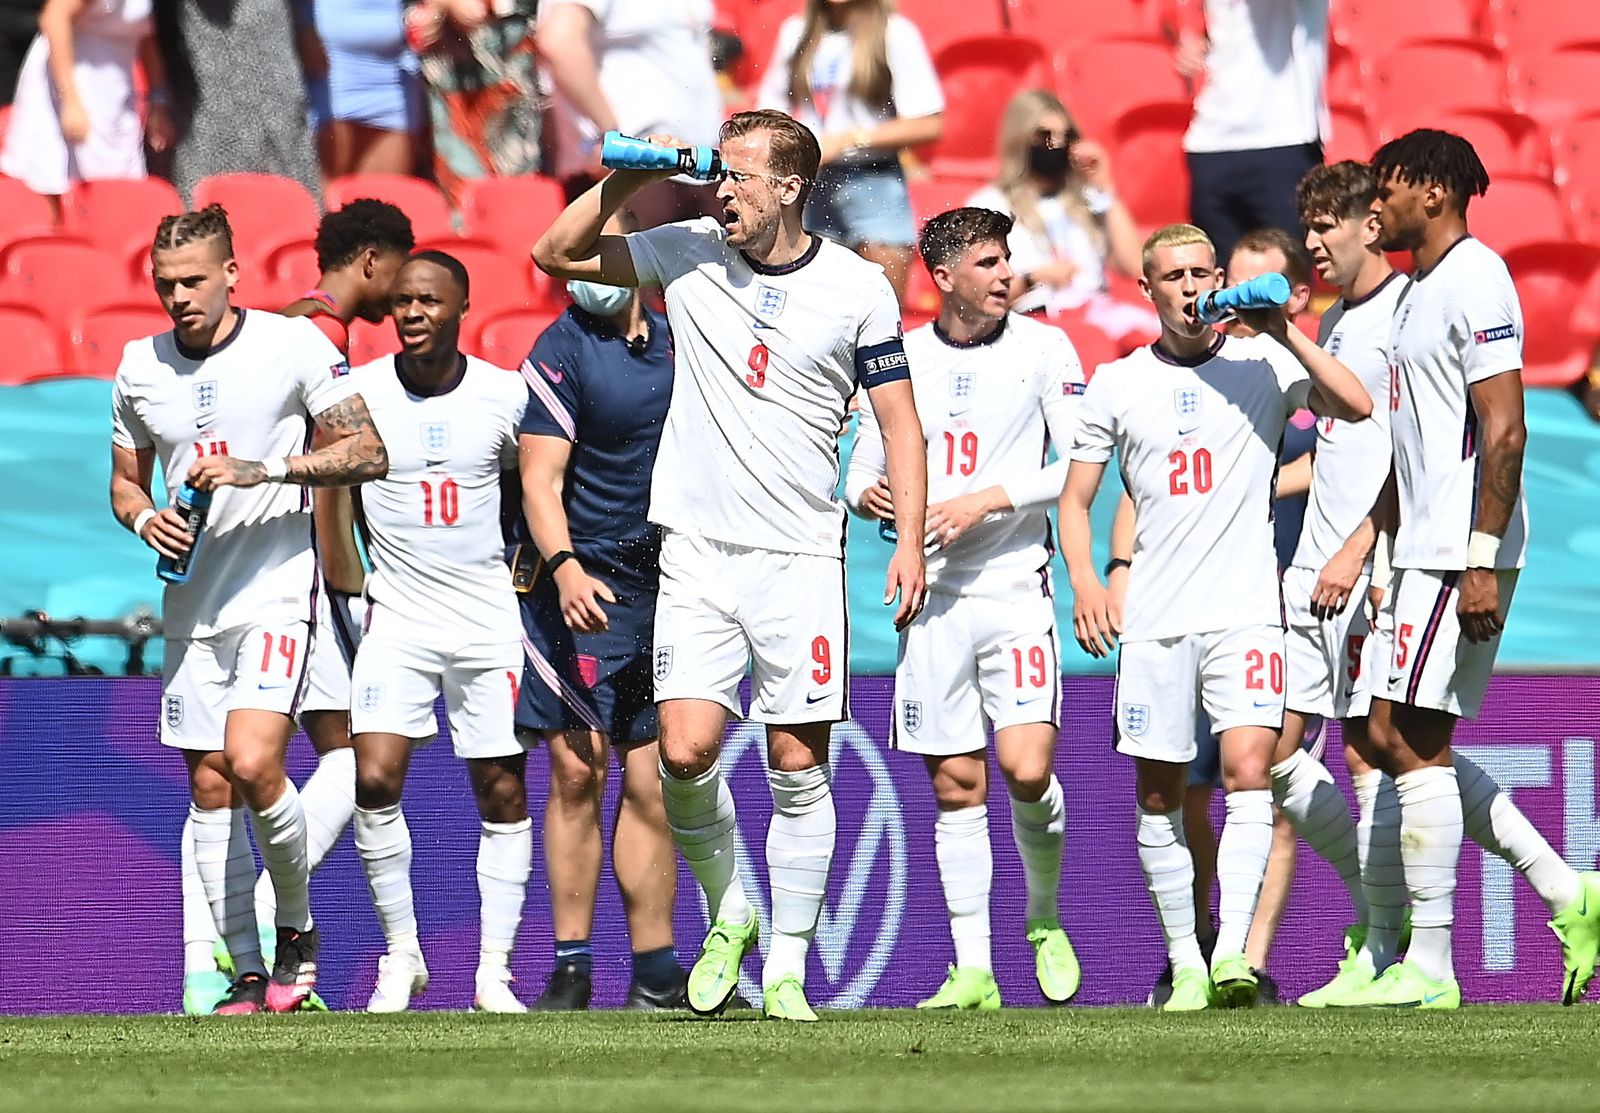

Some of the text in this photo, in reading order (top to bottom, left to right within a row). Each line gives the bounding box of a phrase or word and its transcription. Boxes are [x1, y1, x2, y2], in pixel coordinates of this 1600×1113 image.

[746, 344, 769, 388] 9
[944, 431, 978, 477] 19
[1168, 447, 1213, 496] 20
[420, 478, 459, 526] 10
[261, 632, 296, 678] 14
[811, 635, 831, 685] 9
[1012, 645, 1047, 689] 19
[1245, 649, 1284, 695] 20
[1347, 634, 1364, 682] 5
